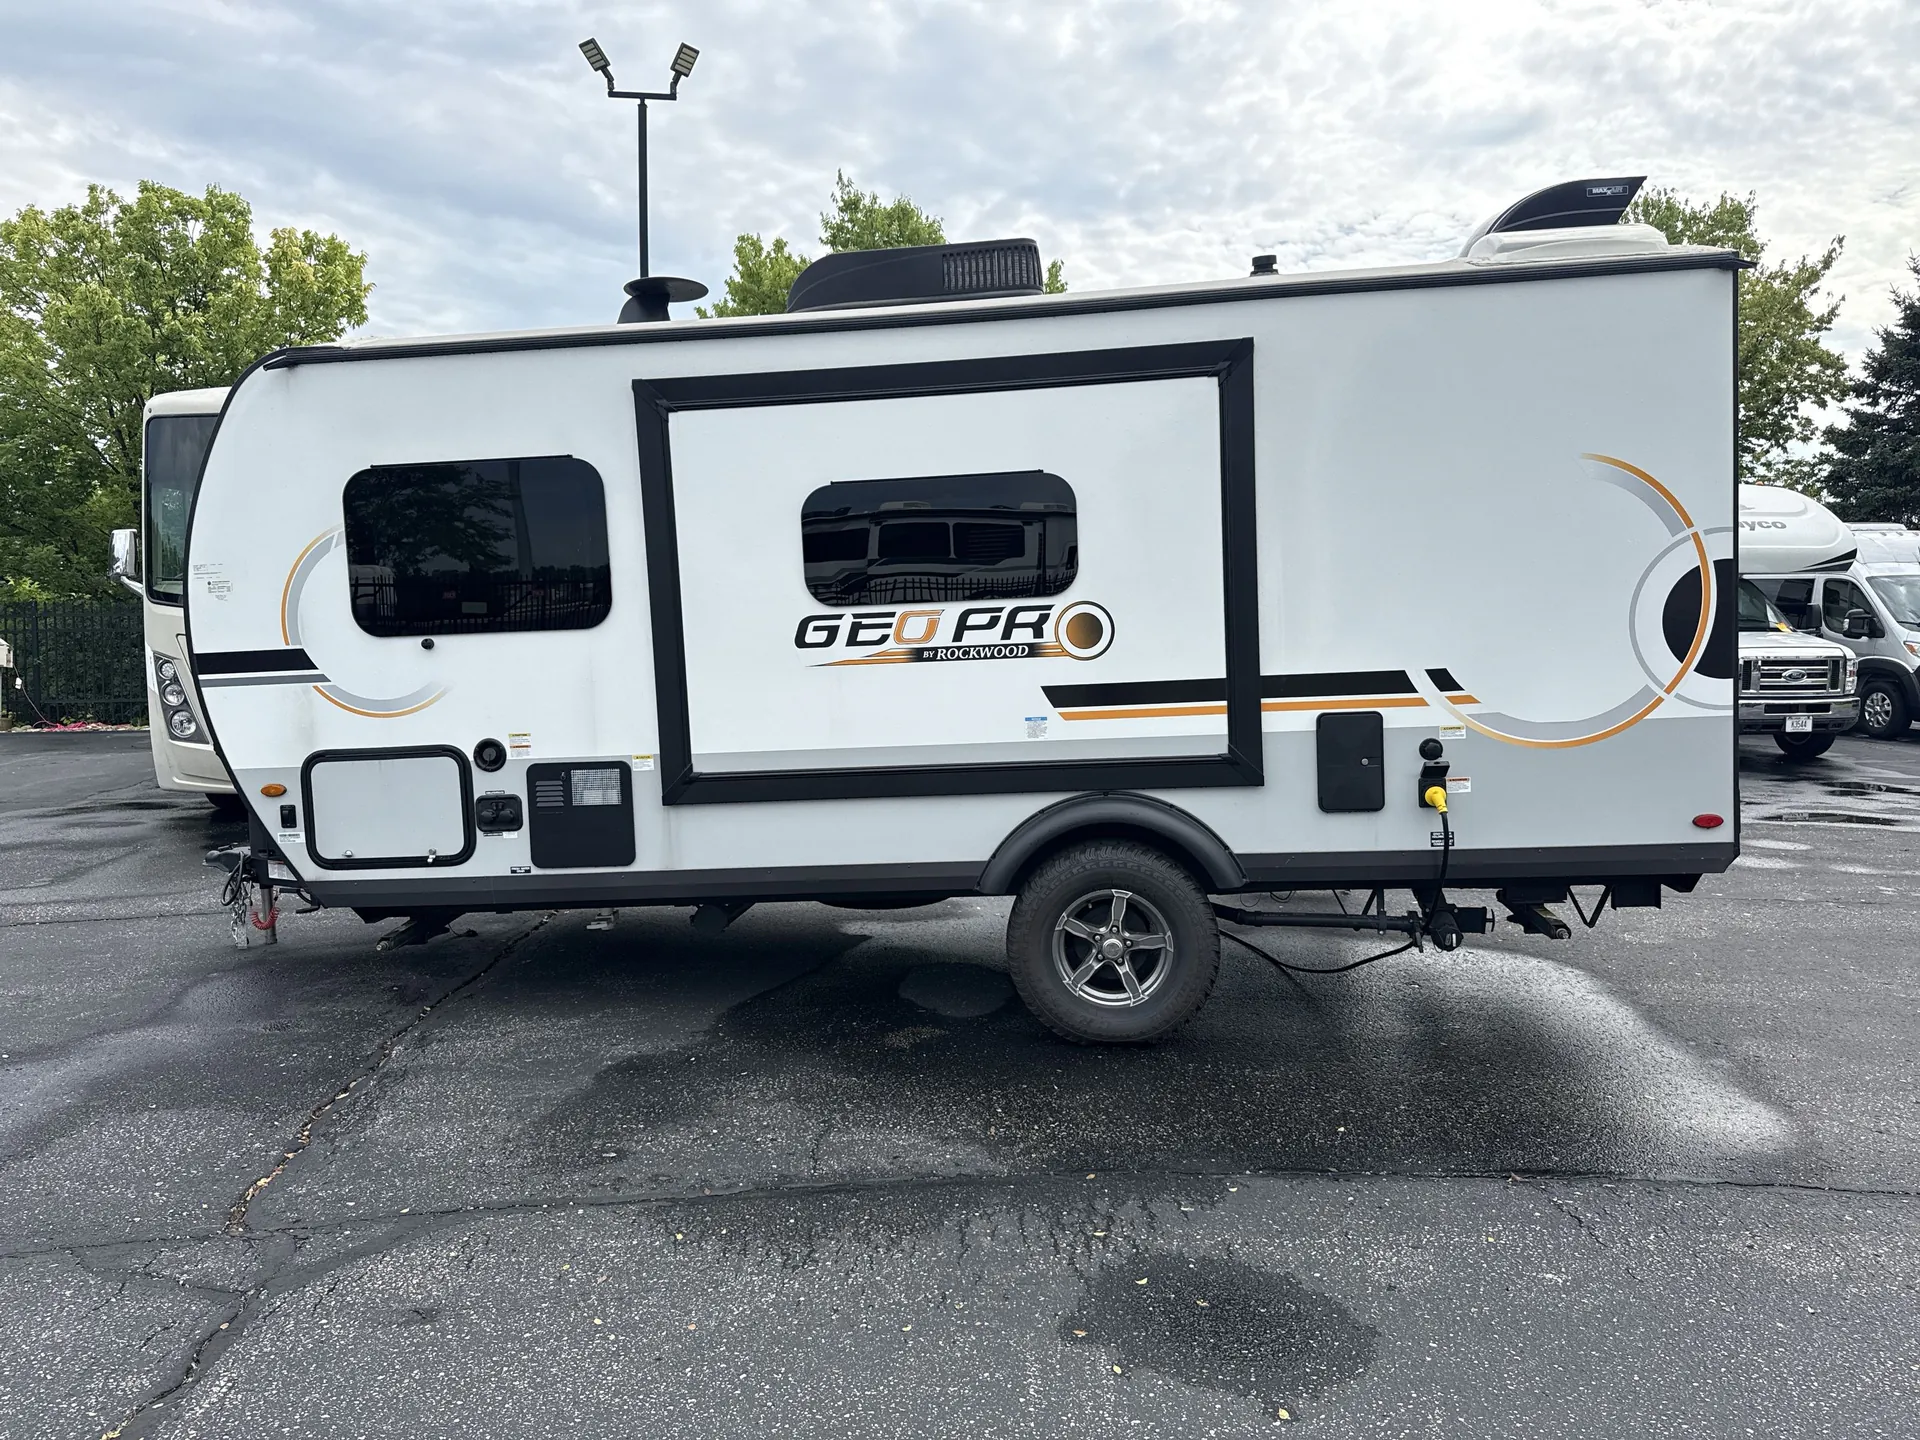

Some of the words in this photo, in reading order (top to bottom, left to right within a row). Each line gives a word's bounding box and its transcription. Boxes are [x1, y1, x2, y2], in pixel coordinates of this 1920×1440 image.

[794, 609, 945, 649] GEO
[923, 650, 935, 659] BY
[936, 645, 1029, 660] ROCKWOOD
